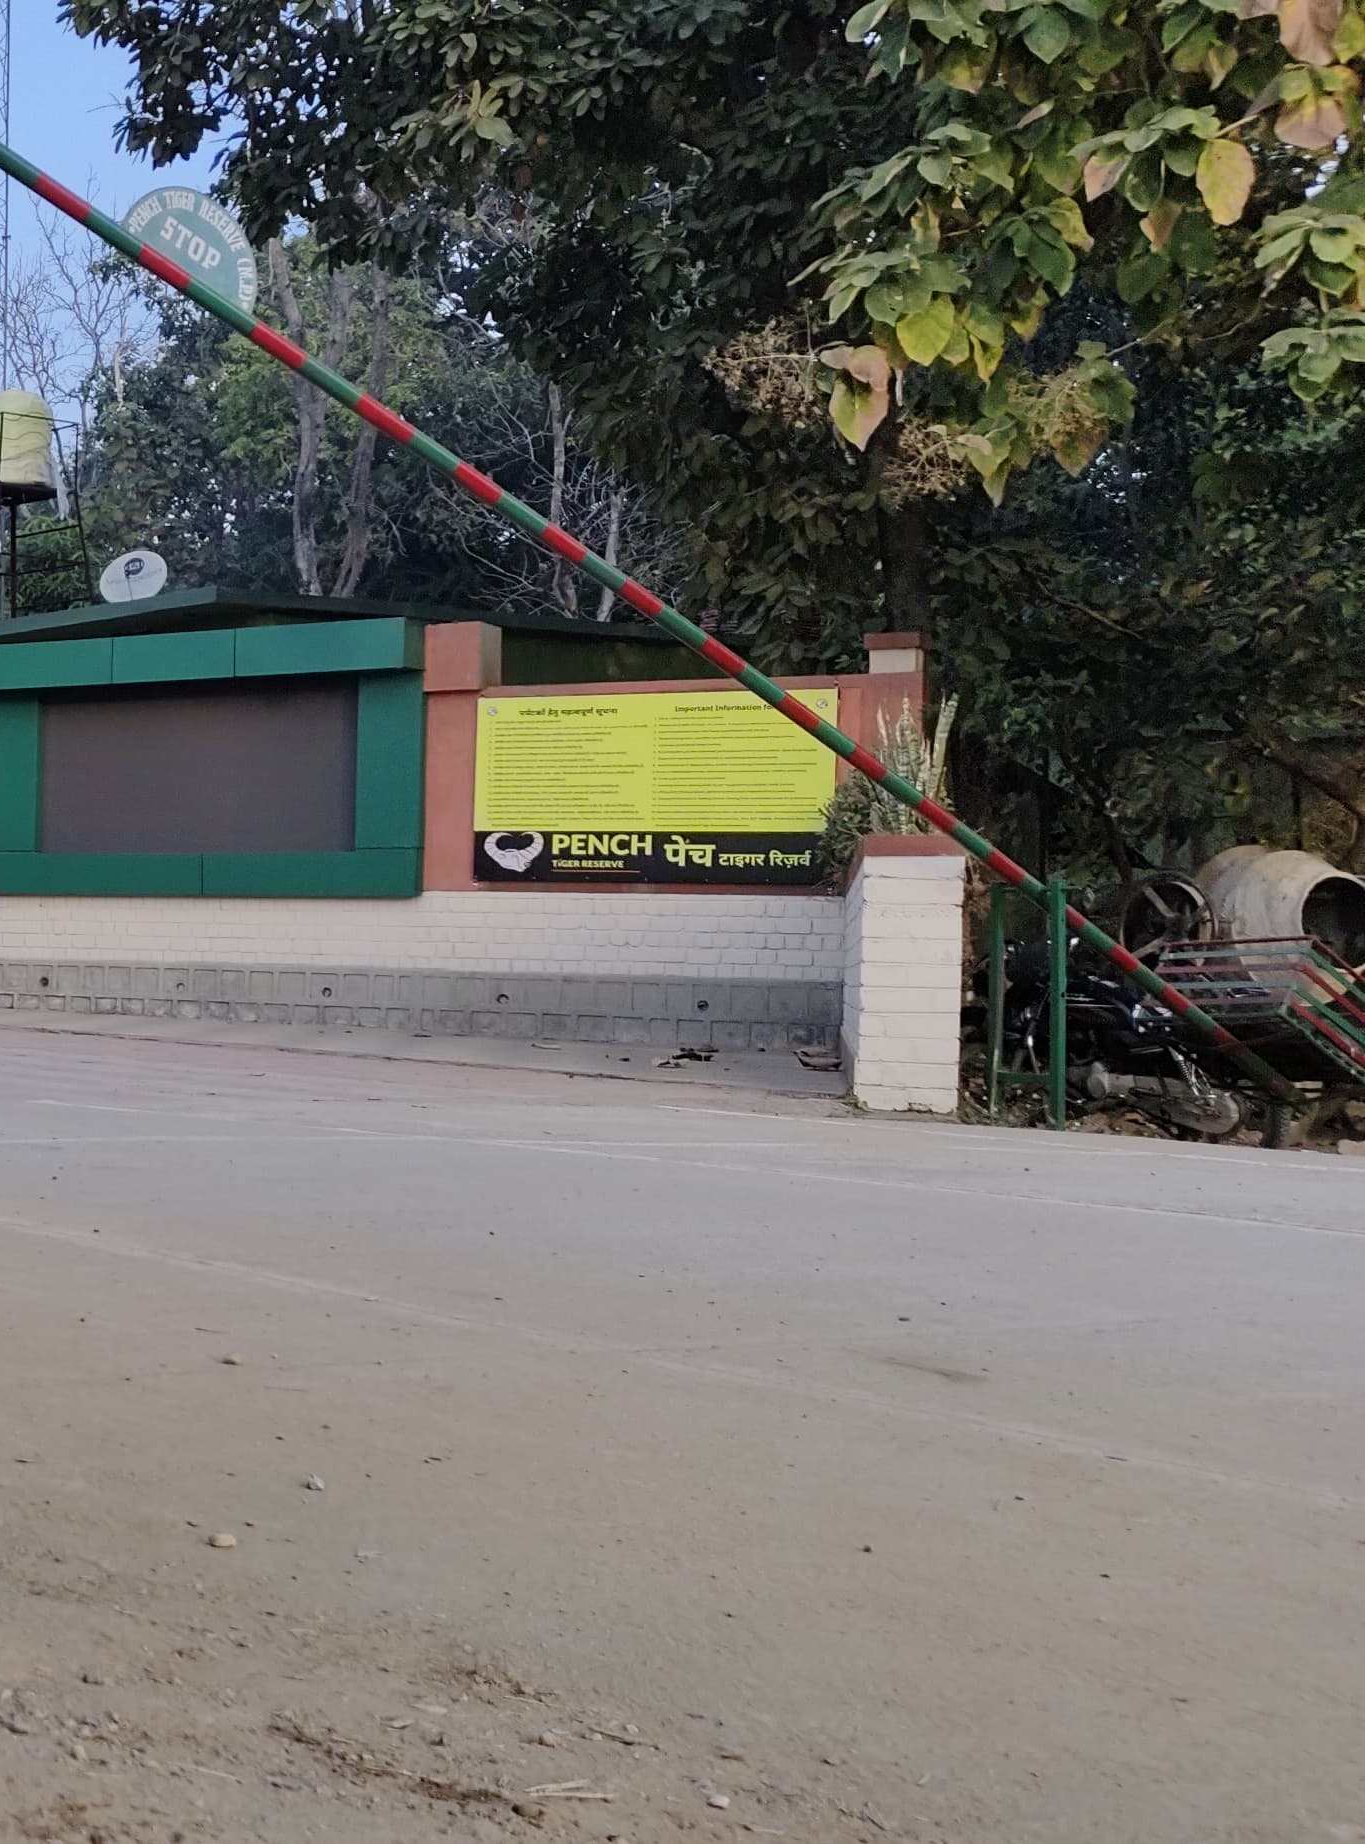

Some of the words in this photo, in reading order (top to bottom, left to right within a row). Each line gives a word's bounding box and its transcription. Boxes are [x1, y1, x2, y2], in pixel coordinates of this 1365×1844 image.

[129, 196, 163, 234] PENCH
[162, 191, 195, 212] TIGER
[198, 200, 245, 252] RESERVE
[160, 215, 222, 269] STOP
[674, 705, 713, 714] Important
[715, 704, 761, 712] Information
[552, 833, 653, 856] PENCH
[663, 834, 716, 867] पेंच
[718, 853, 766, 868] टाइगर
[769, 850, 813, 868] रिज़र्व
[581, 860, 625, 868] RESERVE
